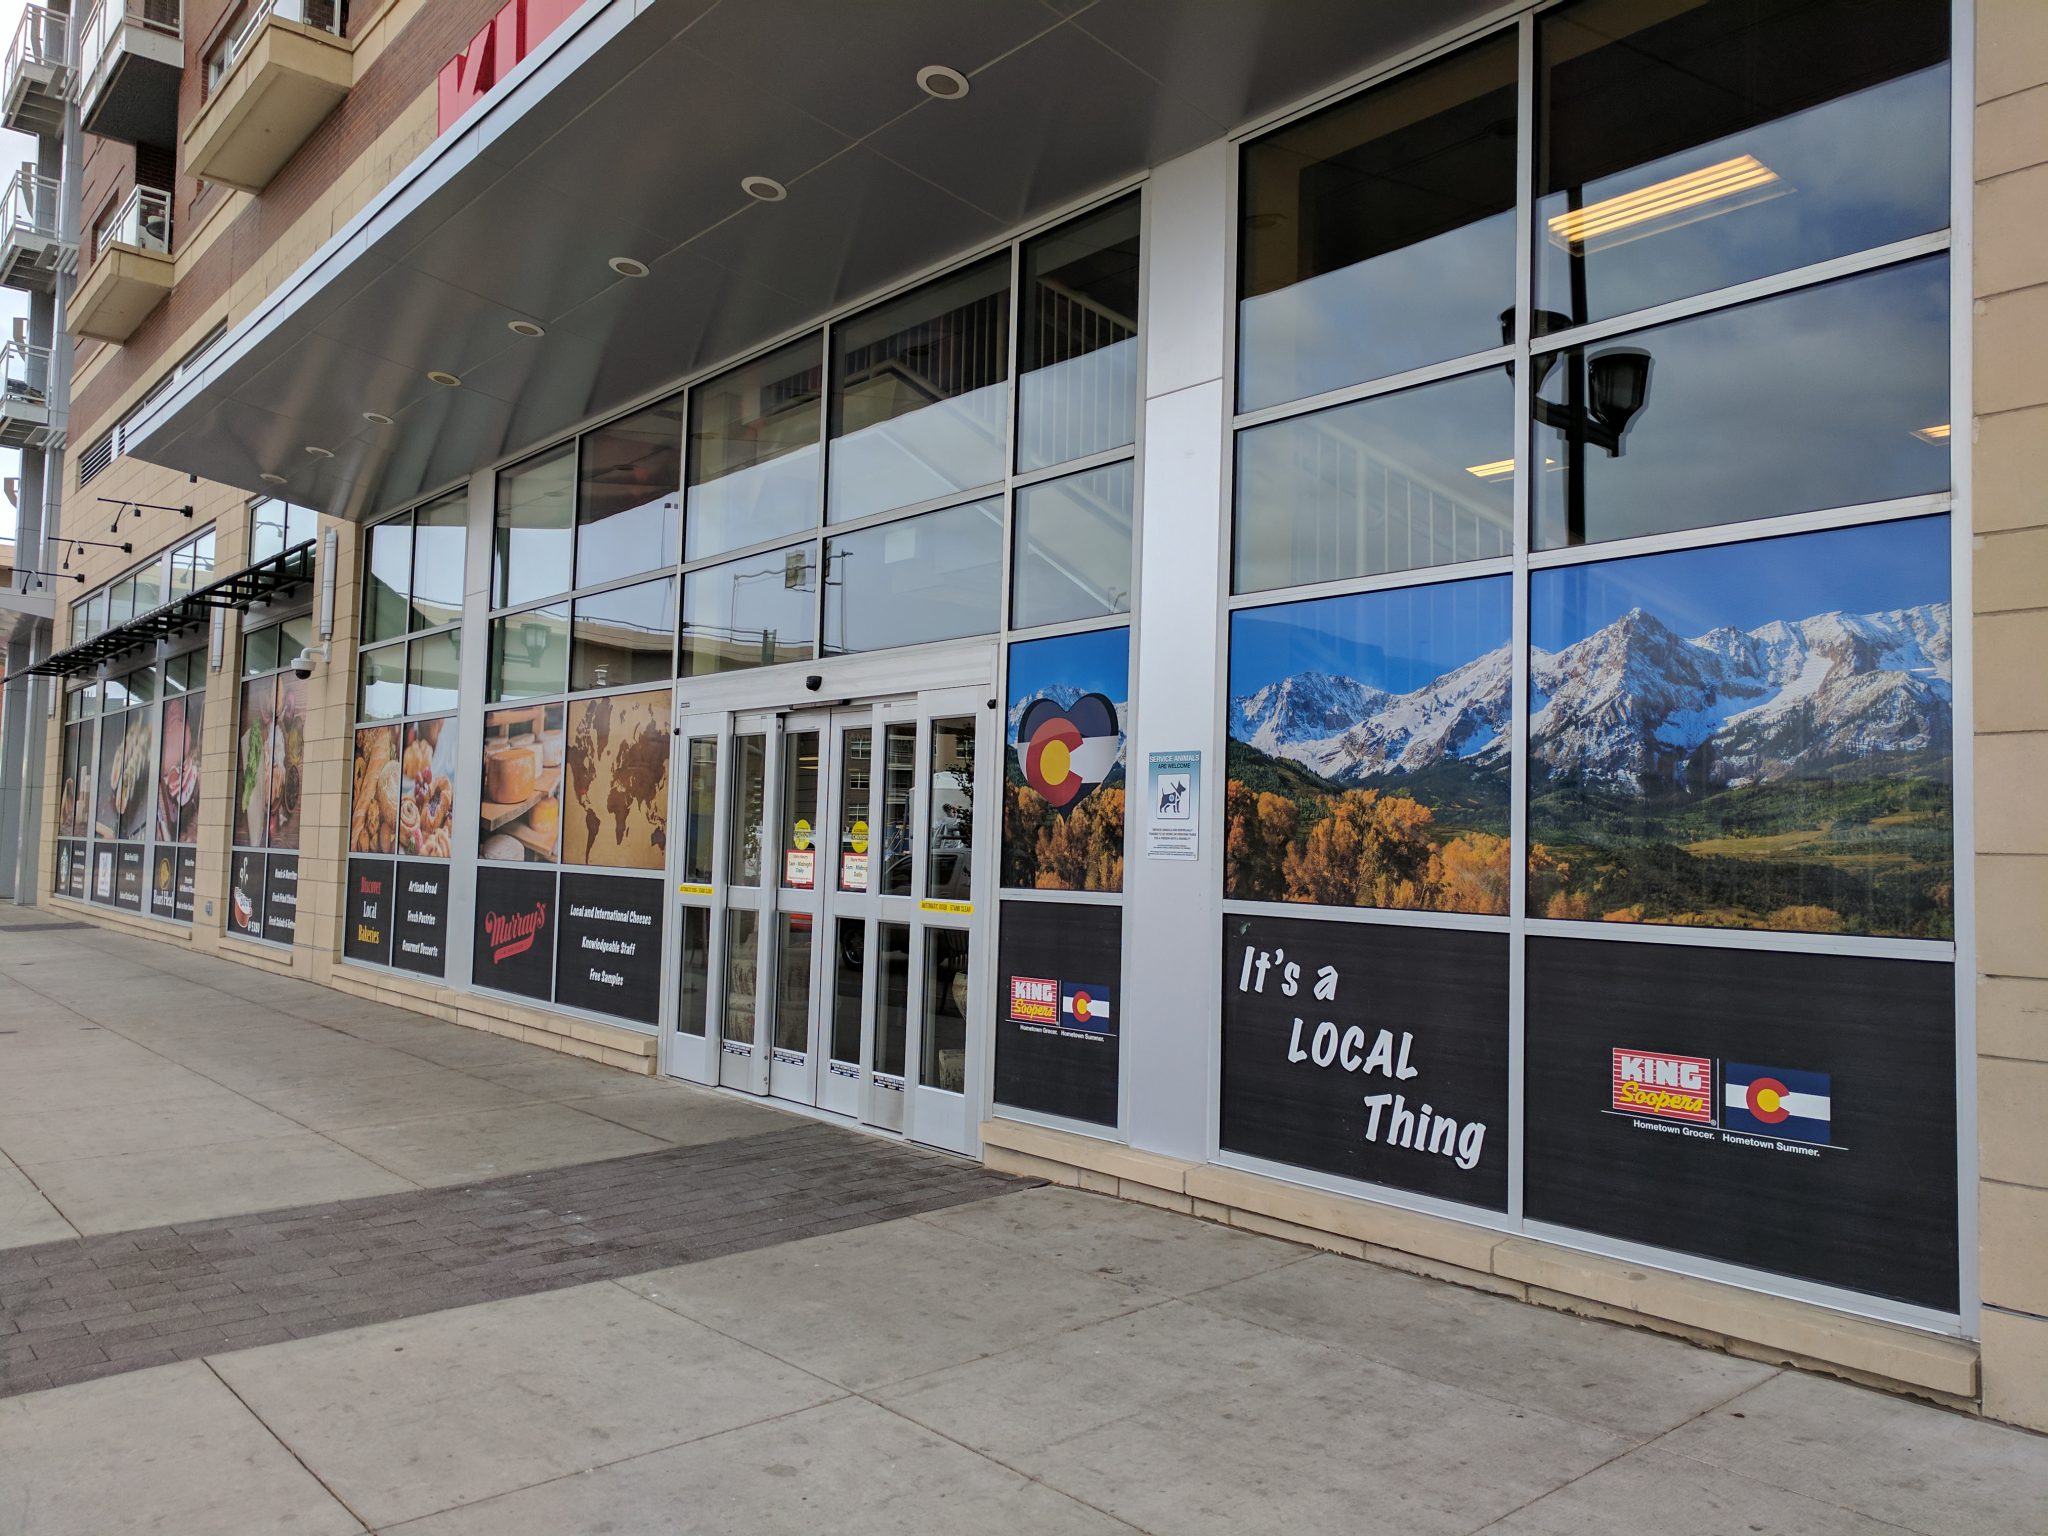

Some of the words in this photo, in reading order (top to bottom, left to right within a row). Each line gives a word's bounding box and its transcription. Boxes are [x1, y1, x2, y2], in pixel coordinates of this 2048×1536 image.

[1149, 755, 1174, 763] SERVICE
[1174, 754, 1200, 762] ANIMALS
[361, 876, 382, 894] Discover
[408, 880, 424, 893] Artisan
[424, 881, 438, 895] Bread
[363, 900, 378, 919] Local
[407, 909, 418, 923] Fresh
[418, 911, 436, 926] Pastries
[570, 904, 584, 916] Local
[584, 908, 595, 919] and
[595, 907, 630, 923] International
[630, 911, 652, 926] Cheeses
[358, 924, 380, 944] Bakeries
[485, 901, 546, 950] Murray's
[402, 939, 420, 954] Gourmet
[420, 942, 438, 957] Desserts
[581, 936, 620, 954] Knowledgeable
[620, 942, 636, 956] Staff
[589, 967, 601, 982] Free
[600, 970, 625, 987] Samples
[1239, 945, 1301, 997] It's
[1313, 965, 1339, 1001] a
[1015, 981, 1053, 1002] KING
[1013, 998, 1053, 1019] Soopers
[1020, 1024, 1042, 1033] Hometown
[1060, 1030, 1084, 1039] Hometown
[1287, 1017, 1418, 1081] LOCAL
[1620, 1055, 1702, 1090] KING
[1618, 1080, 1704, 1114] Soopers
[1363, 1093, 1487, 1170] Thing
[1633, 1119, 1681, 1135] Hometown
[1682, 1126, 1716, 1140] Grocer.
[1722, 1133, 1775, 1150] Hometown
[1776, 1141, 1821, 1158] Summer.
